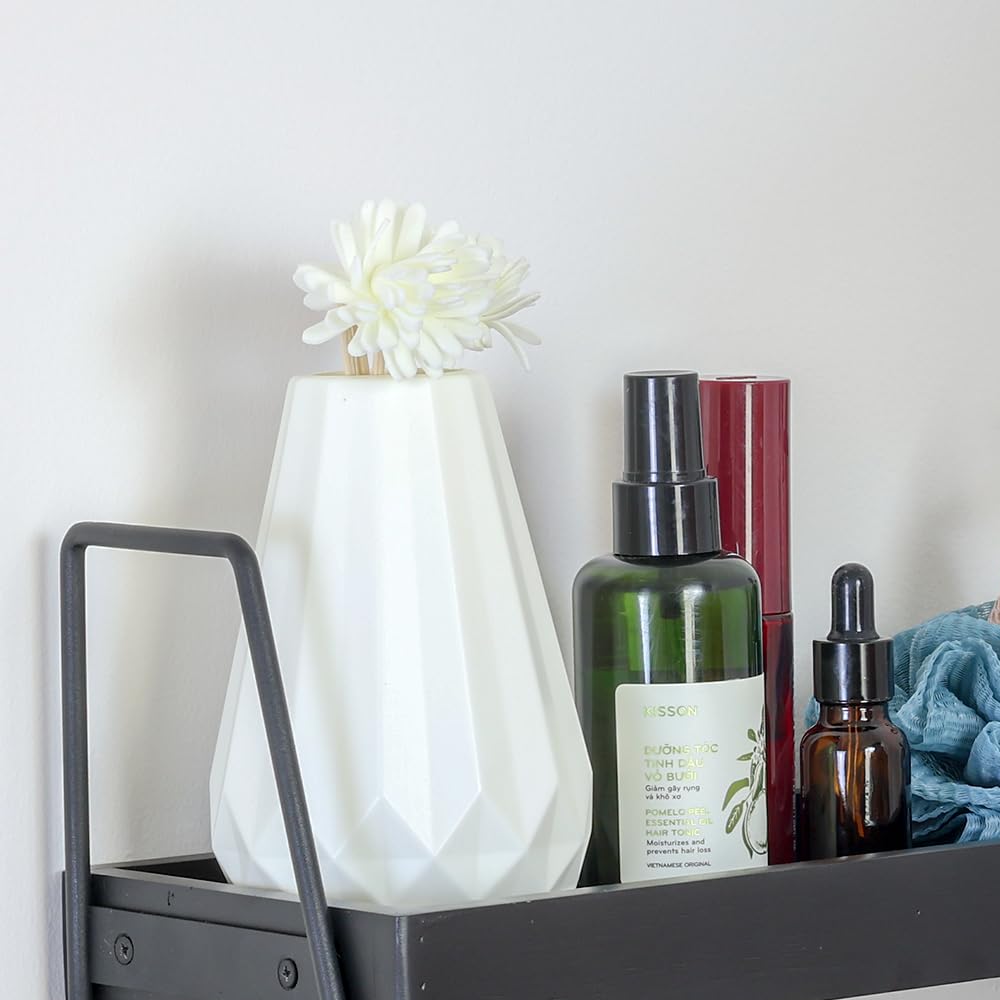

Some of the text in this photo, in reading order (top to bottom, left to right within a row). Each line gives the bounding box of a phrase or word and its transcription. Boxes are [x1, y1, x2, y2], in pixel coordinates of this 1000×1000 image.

[644, 705, 698, 718] KISSON
[645, 808, 685, 816] POMELO
[645, 819, 696, 827] ESSENTIAL
[645, 829, 668, 837] HAIR
[646, 838, 705, 847] Moisturizes and
[646, 848, 679, 856] prevents
